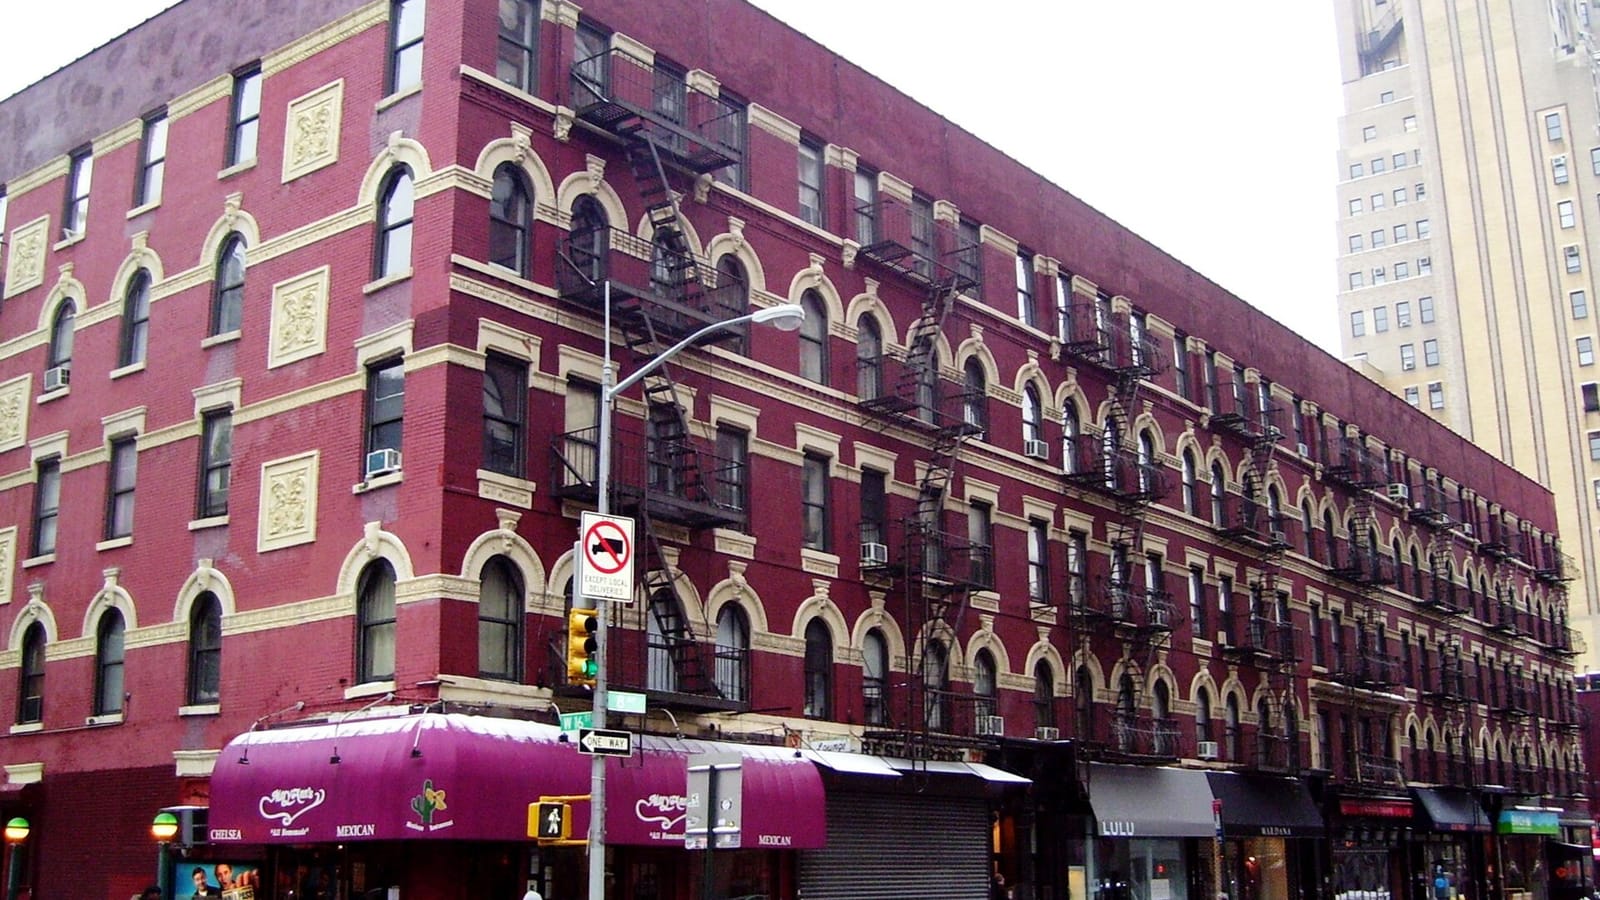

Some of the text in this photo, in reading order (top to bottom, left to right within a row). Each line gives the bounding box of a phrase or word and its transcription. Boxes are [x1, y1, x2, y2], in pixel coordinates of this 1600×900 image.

[584, 574, 628, 588] EXCEPT LOCAL
[589, 585, 623, 596] DELIVERIES
[563, 715, 572, 730] W
[587, 736, 625, 748] ONE WAY
[210, 829, 242, 840] CHELSEA
[336, 824, 375, 837] MEXICAN
[1102, 821, 1135, 836] LULU
[758, 834, 792, 846] MEXICAN
